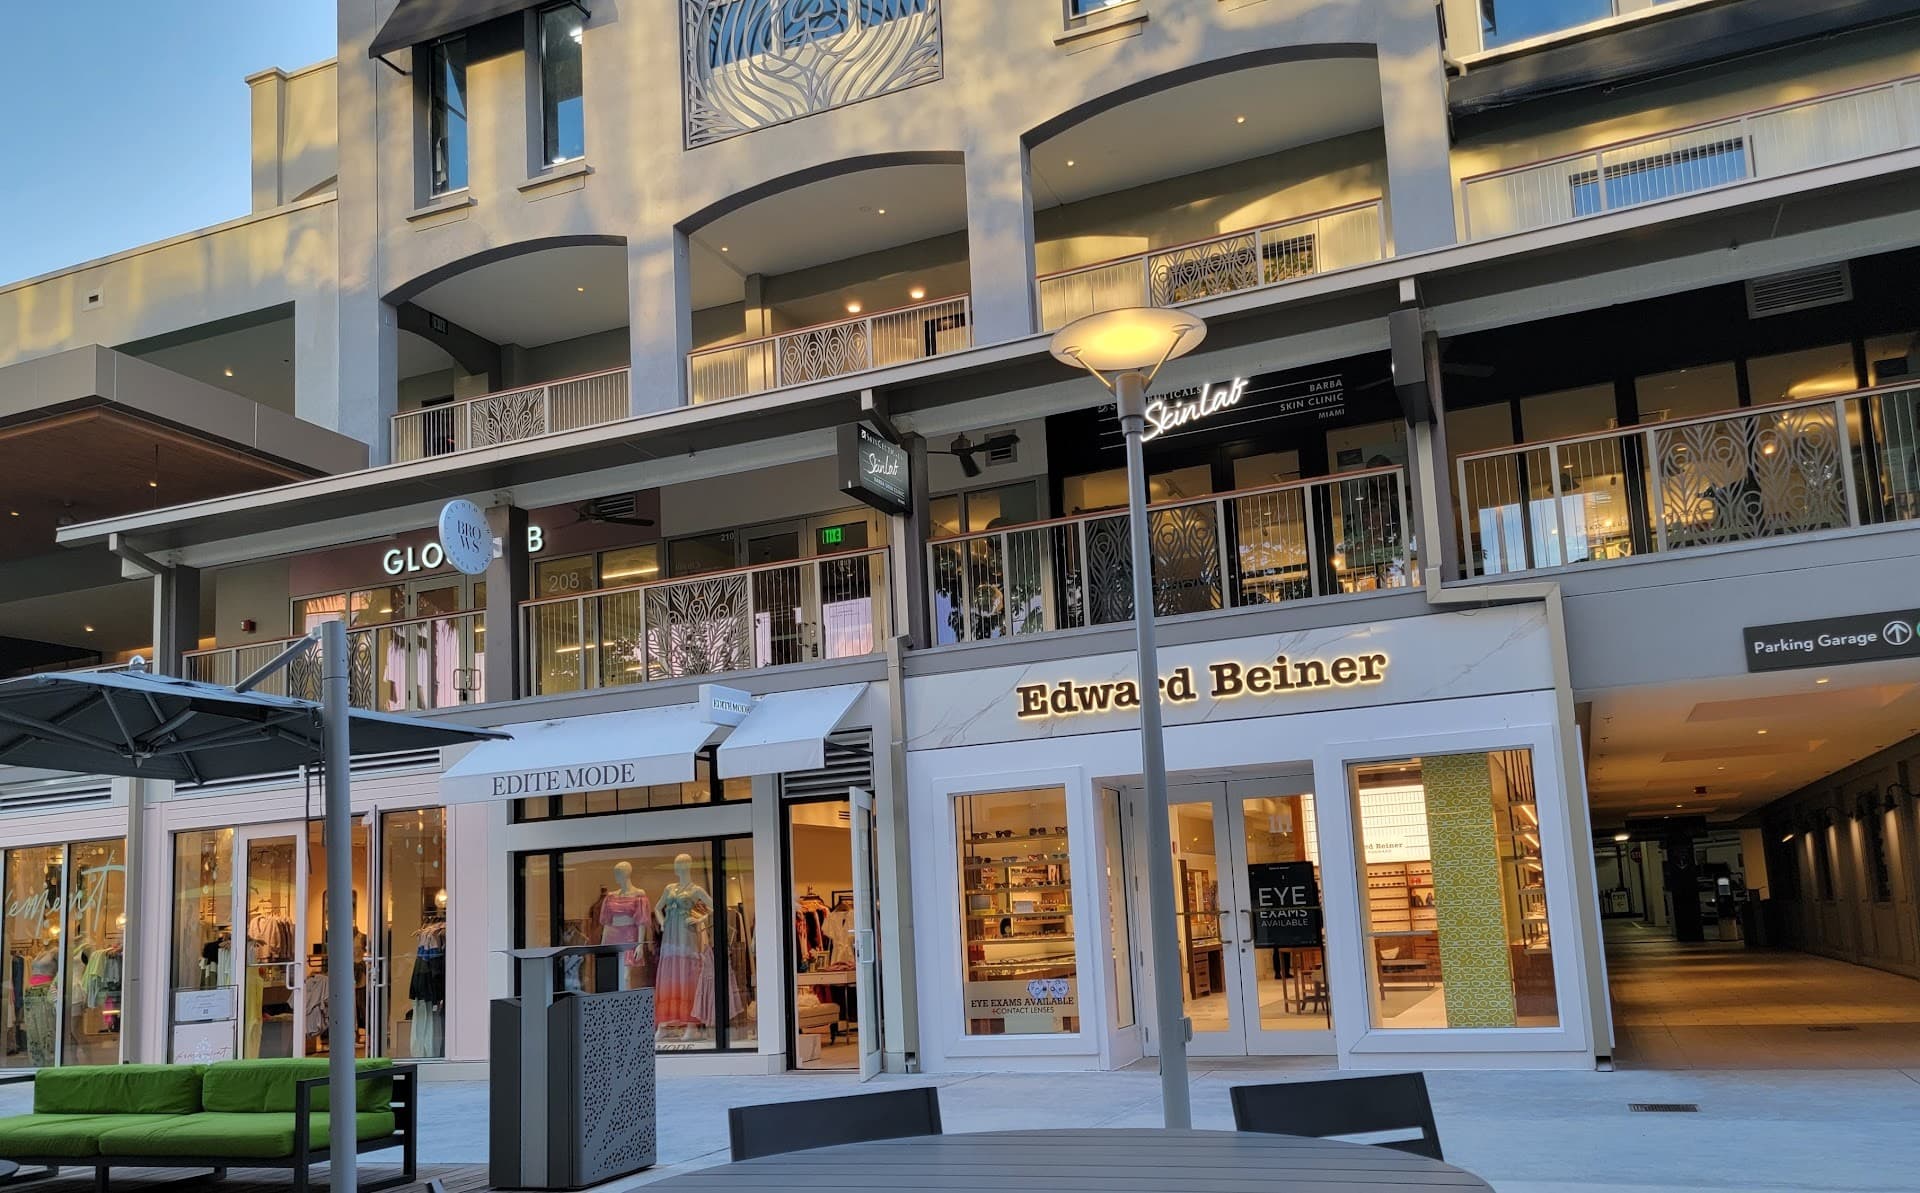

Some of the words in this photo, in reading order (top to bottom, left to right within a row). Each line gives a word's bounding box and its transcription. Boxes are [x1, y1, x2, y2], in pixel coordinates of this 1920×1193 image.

[1309, 379, 1343, 392] BARBA
[1280, 400, 1304, 412] SKIN
[1308, 392, 1344, 406] CLINIC
[1318, 408, 1345, 419] MIAMI
[720, 531, 735, 542] 210
[549, 572, 580, 592] 208
[1754, 638, 1814, 654] Parking
[1817, 633, 1878, 647] Garage
[1016, 668, 1197, 718] Edwad
[1209, 653, 1387, 698] Beiner
[492, 769, 561, 797] EDITE
[565, 763, 636, 788] MODE
[1259, 886, 1307, 907] EYE
[1260, 908, 1308, 919] EXAMS
[1261, 918, 1309, 927] AVAILABLE
[971, 999, 989, 1008] EYE
[991, 998, 1022, 1007] EXAMS
[1024, 997, 1074, 1006] AVAILABLE
[1030, 1006, 1055, 1014] LENSES
